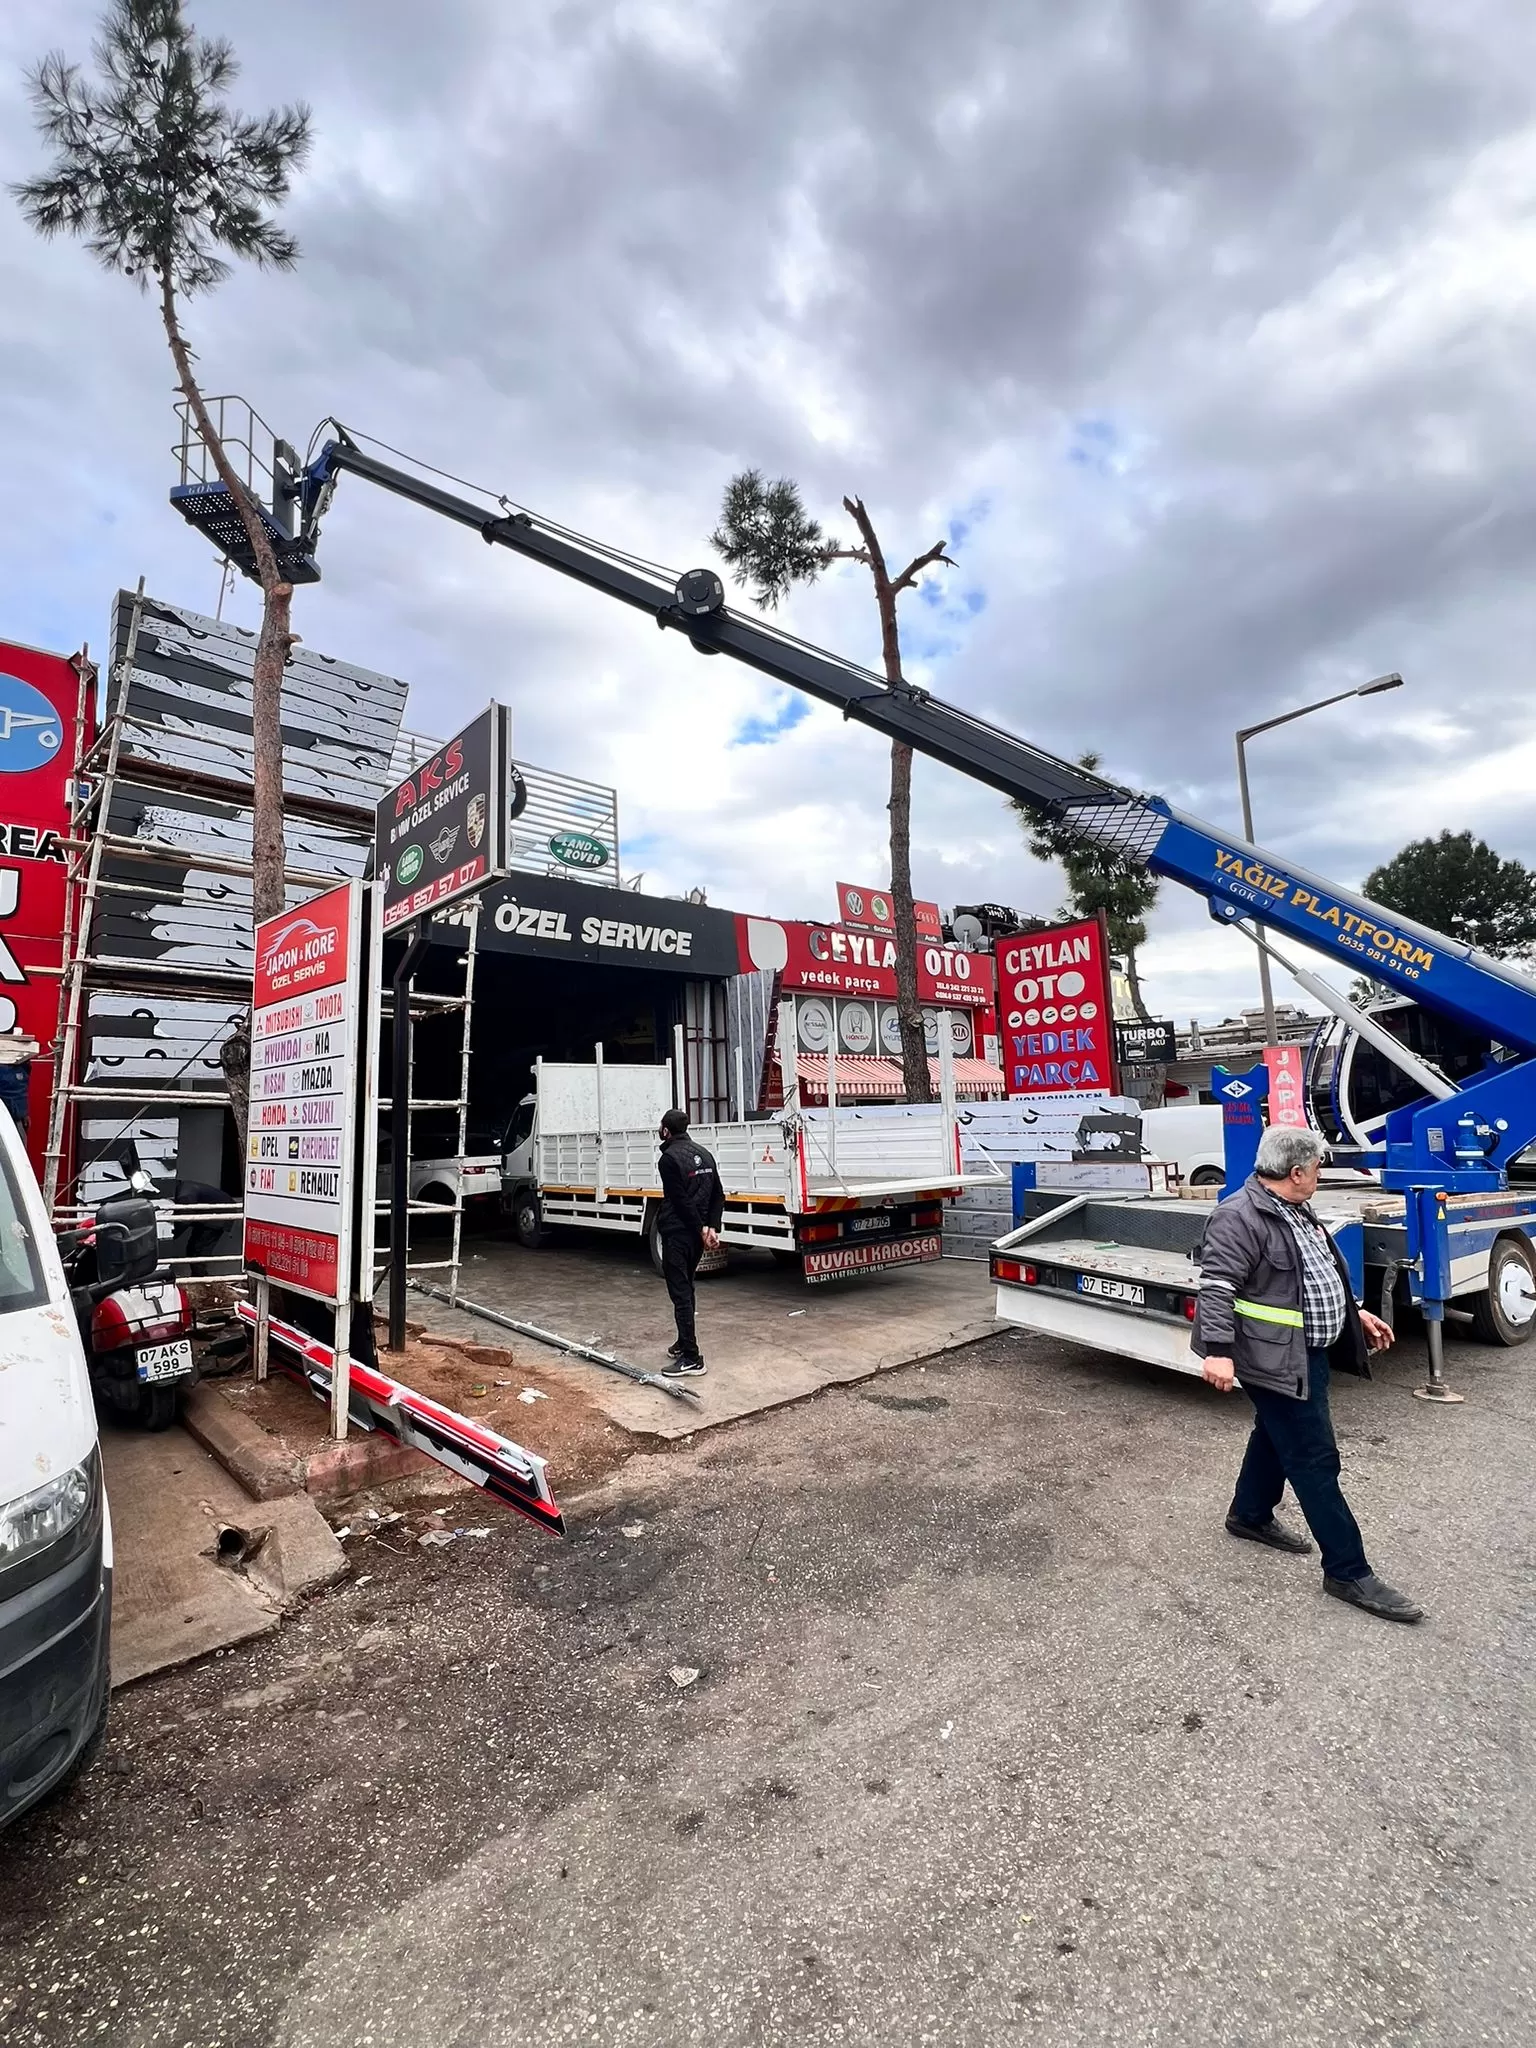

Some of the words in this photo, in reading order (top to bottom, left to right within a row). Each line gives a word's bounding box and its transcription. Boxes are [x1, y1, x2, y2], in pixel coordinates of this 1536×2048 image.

[395, 738, 464, 817] AKS
[411, 806, 433, 828] ÖZEL
[434, 772, 470, 812] SERVICE
[561, 837, 593, 851] LAND
[563, 848, 602, 864] ROVER
[439, 872, 455, 896] 57
[460, 860, 477, 884] 07
[1214, 848, 1290, 899] YAĞIZ
[1290, 888, 1435, 971] PLATFORM
[494, 894, 573, 942] ÖZEL
[581, 916, 693, 957] SERVICE
[266, 948, 298, 977] JAPON
[305, 932, 335, 962] KORE
[809, 931, 897, 971] CEYLA
[924, 948, 971, 980] OTO
[1005, 935, 1091, 975] CEYLAN
[1337, 933, 1365, 952] 0535
[1365, 945, 1387, 964] 981
[1388, 958, 1403, 972] 91
[1404, 966, 1420, 980] 06
[271, 973, 293, 991] ÖZEL
[800, 969, 840, 988] yedek
[845, 973, 880, 991] parça
[265, 1005, 302, 1034] MITSUBISHI
[315, 992, 343, 1021] TOYOTA
[264, 1037, 302, 1064] HYUNDAI
[315, 1031, 330, 1055] KIA
[952, 1027, 967, 1038] KIA
[1012, 1027, 1096, 1057] YEDEK
[1122, 1027, 1165, 1042] TURBO
[263, 1071, 286, 1095] NISSAN
[301, 1065, 333, 1092] MAZDA
[1014, 1060, 1099, 1092] PARÇA
[261, 1104, 287, 1125] HONDA
[302, 1100, 334, 1125] SUZUKI
[261, 1136, 279, 1157] OPEL
[301, 1136, 339, 1160] CHEVROLET
[260, 1168, 276, 1190] FIAT
[300, 1171, 339, 1198] RENAULT
[810, 1248, 868, 1271] YUVALI
[871, 1237, 938, 1261] KAROSER
[1082, 1275, 1096, 1290] 07
[1101, 1280, 1125, 1297] EFJ
[1131, 1287, 1144, 1301] 71
[140, 1349, 156, 1363] 07
[161, 1342, 188, 1359] AKS
